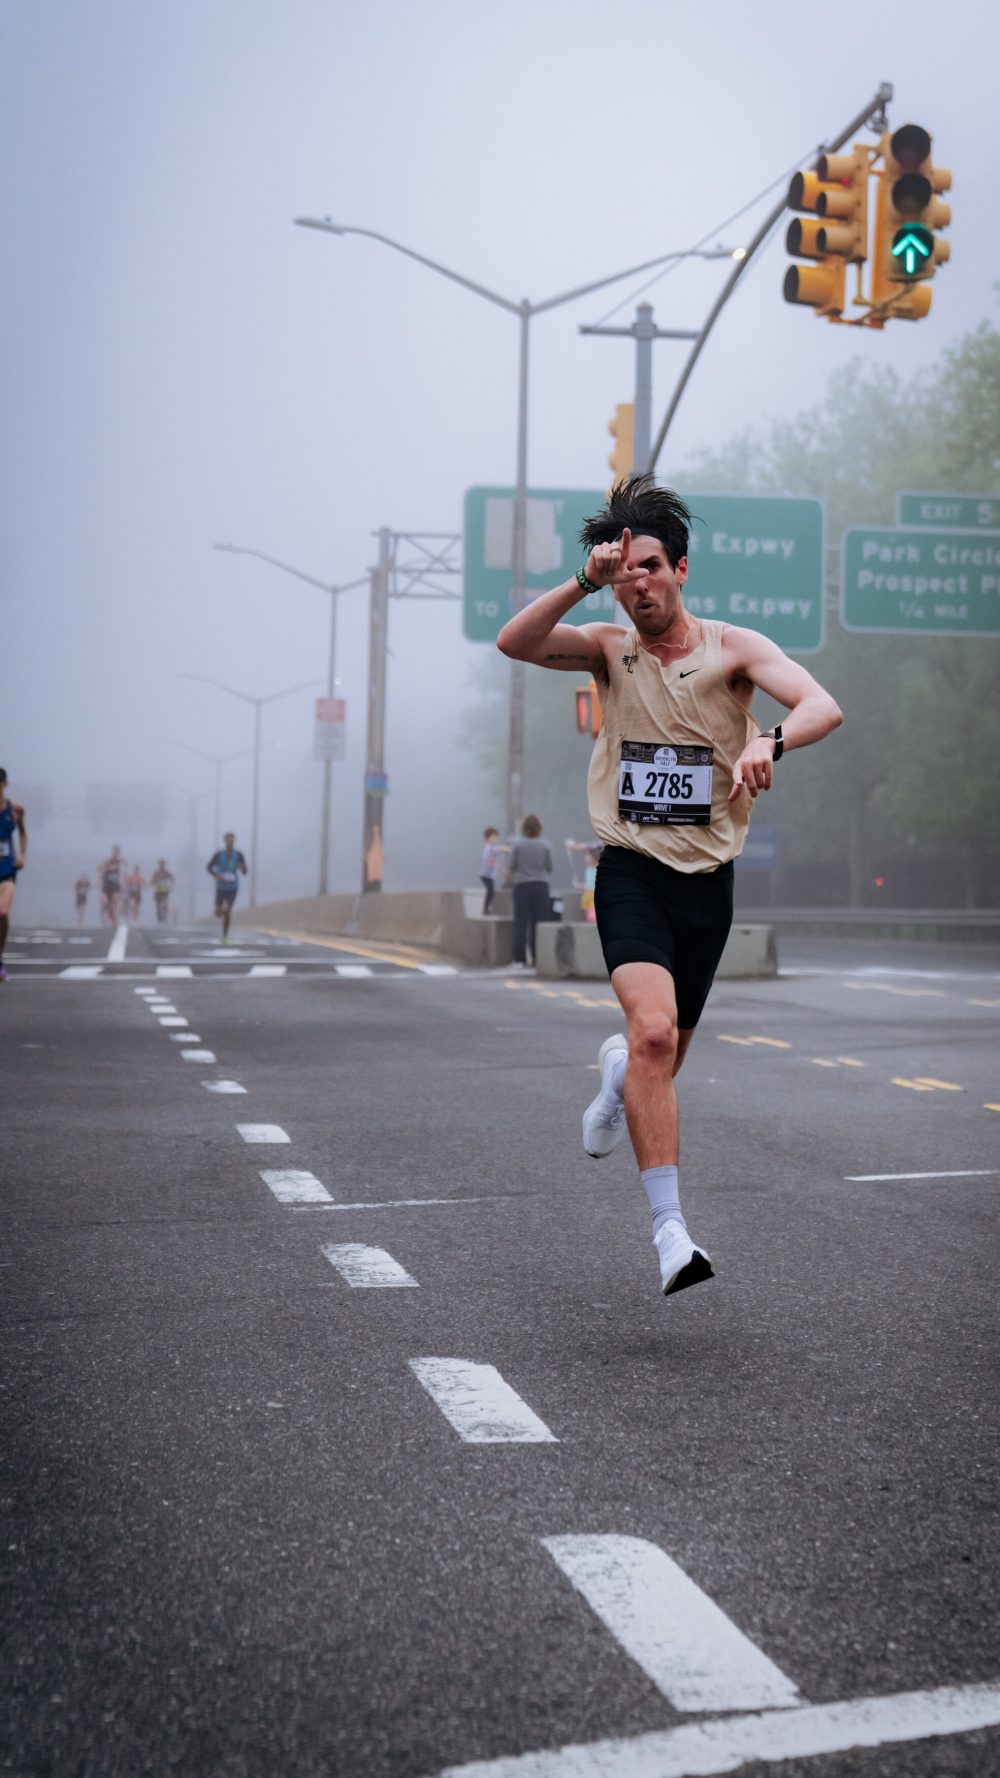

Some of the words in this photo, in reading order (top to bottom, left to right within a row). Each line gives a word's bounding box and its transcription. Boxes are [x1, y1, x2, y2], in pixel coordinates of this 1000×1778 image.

[920, 502, 961, 521] EXIT
[711, 532, 795, 559] Expwy
[862, 540, 920, 563] Park
[576, 567, 597, 592] BOYS
[857, 570, 969, 597] Prospect
[474, 600, 499, 617] TO
[728, 593, 813, 620] Expwy
[933, 603, 970, 619] MILE
[621, 772, 635, 795] A
[644, 771, 693, 799] 2785
